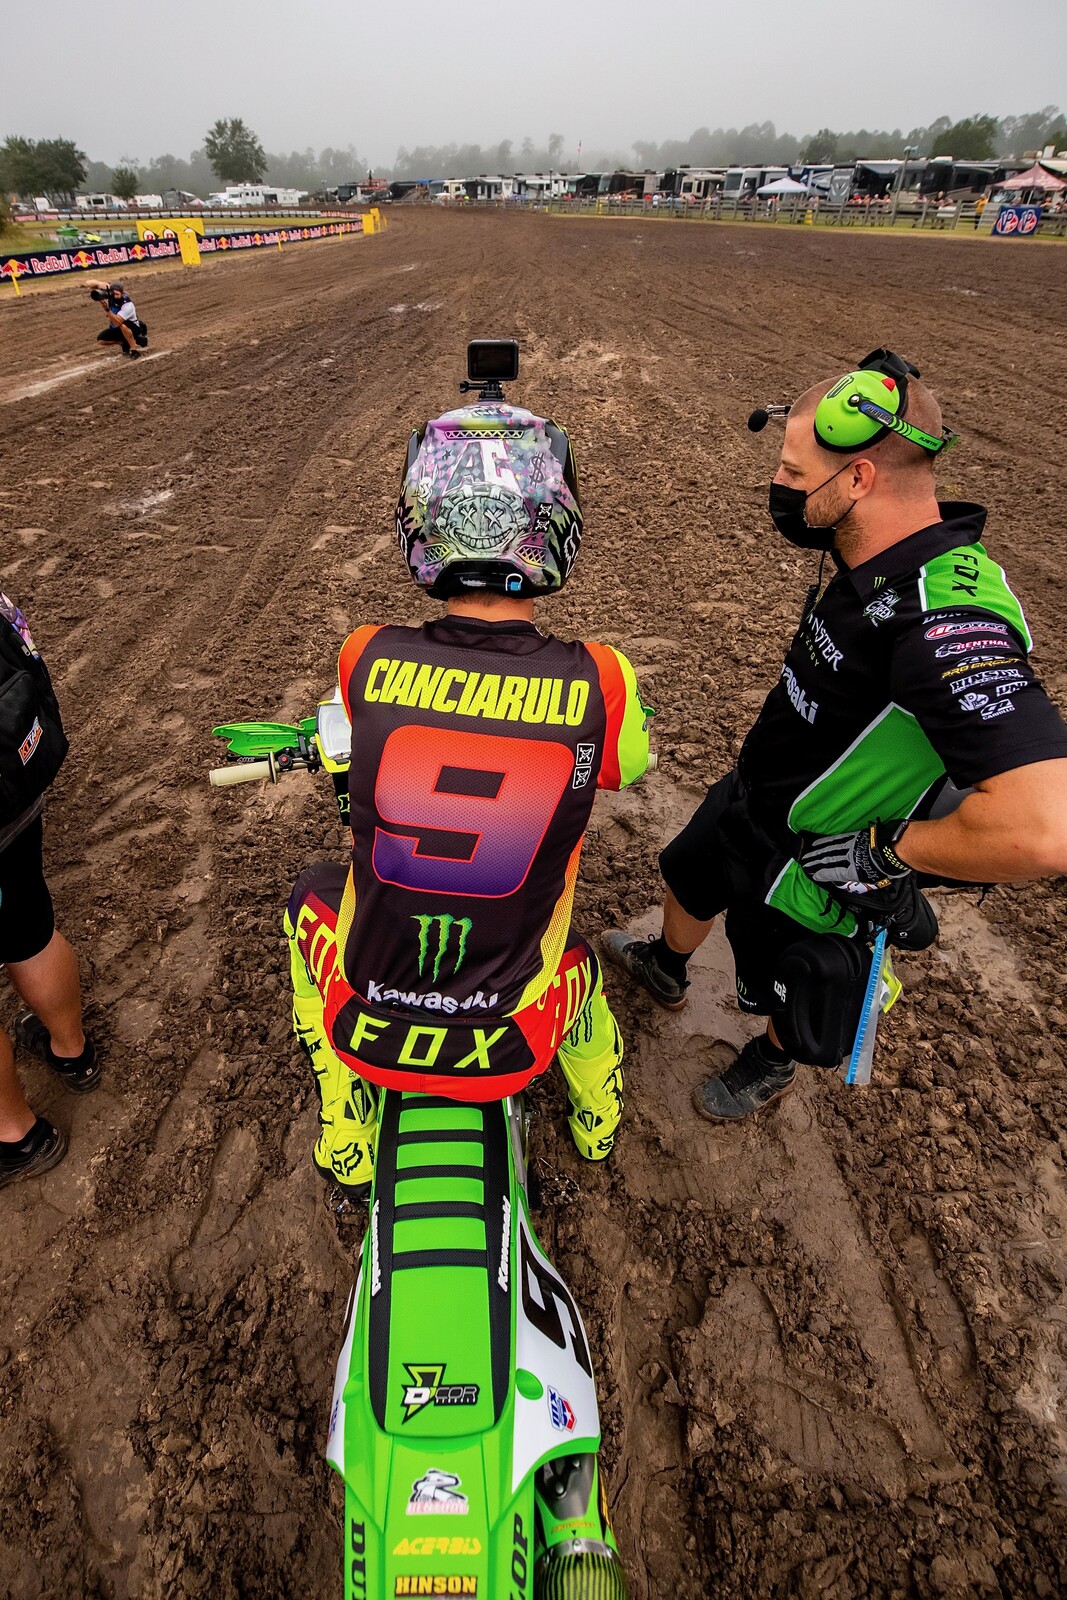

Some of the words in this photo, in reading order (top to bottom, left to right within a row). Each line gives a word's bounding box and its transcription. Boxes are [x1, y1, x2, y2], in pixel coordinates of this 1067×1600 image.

[952, 553, 979, 597] FOX
[364, 658, 590, 726] CIANCIARULO
[372, 724, 575, 898] 9
[350, 1012, 508, 1069] FOX
[351, 1518, 367, 1600] DU
[392, 1537, 481, 1555] ACERBIS
[510, 1512, 528, 1600] OP
[395, 1576, 477, 1595] HINSON
